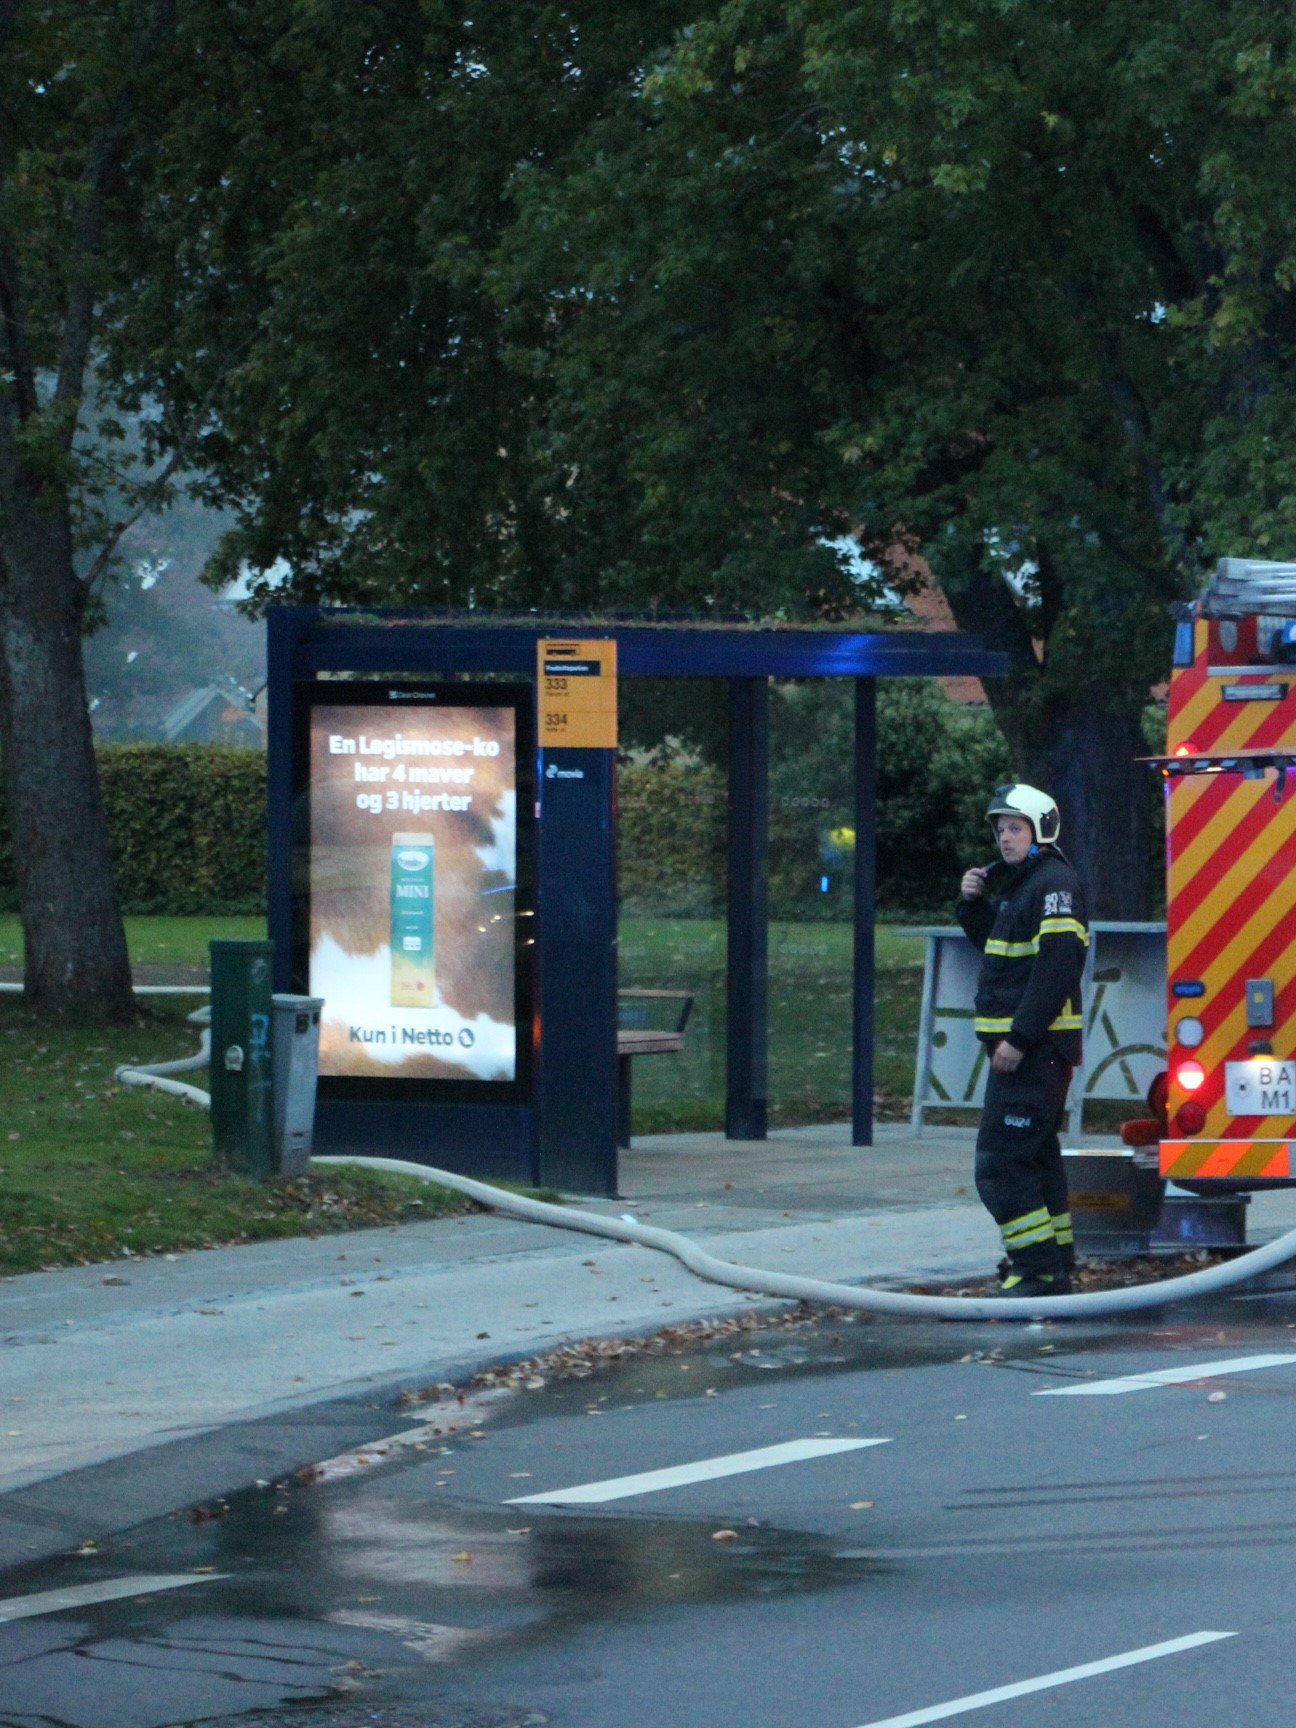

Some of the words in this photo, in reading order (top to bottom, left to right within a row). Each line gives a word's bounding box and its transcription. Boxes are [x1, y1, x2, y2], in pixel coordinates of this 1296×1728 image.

[545, 678, 568, 690] 333
[545, 714, 568, 726] 334
[329, 735, 356, 754] En
[354, 762, 390, 782] har
[392, 764, 407, 782] 4
[408, 767, 475, 784] maver
[356, 793, 383, 814] og
[386, 791, 399, 810] 3
[402, 789, 473, 815] hjerter
[396, 885, 430, 898] MINI
[349, 1026, 386, 1043] Kun
[391, 1025, 397, 1044] i
[402, 1027, 453, 1046] Netto
[1261, 1090, 1290, 1109] M1
